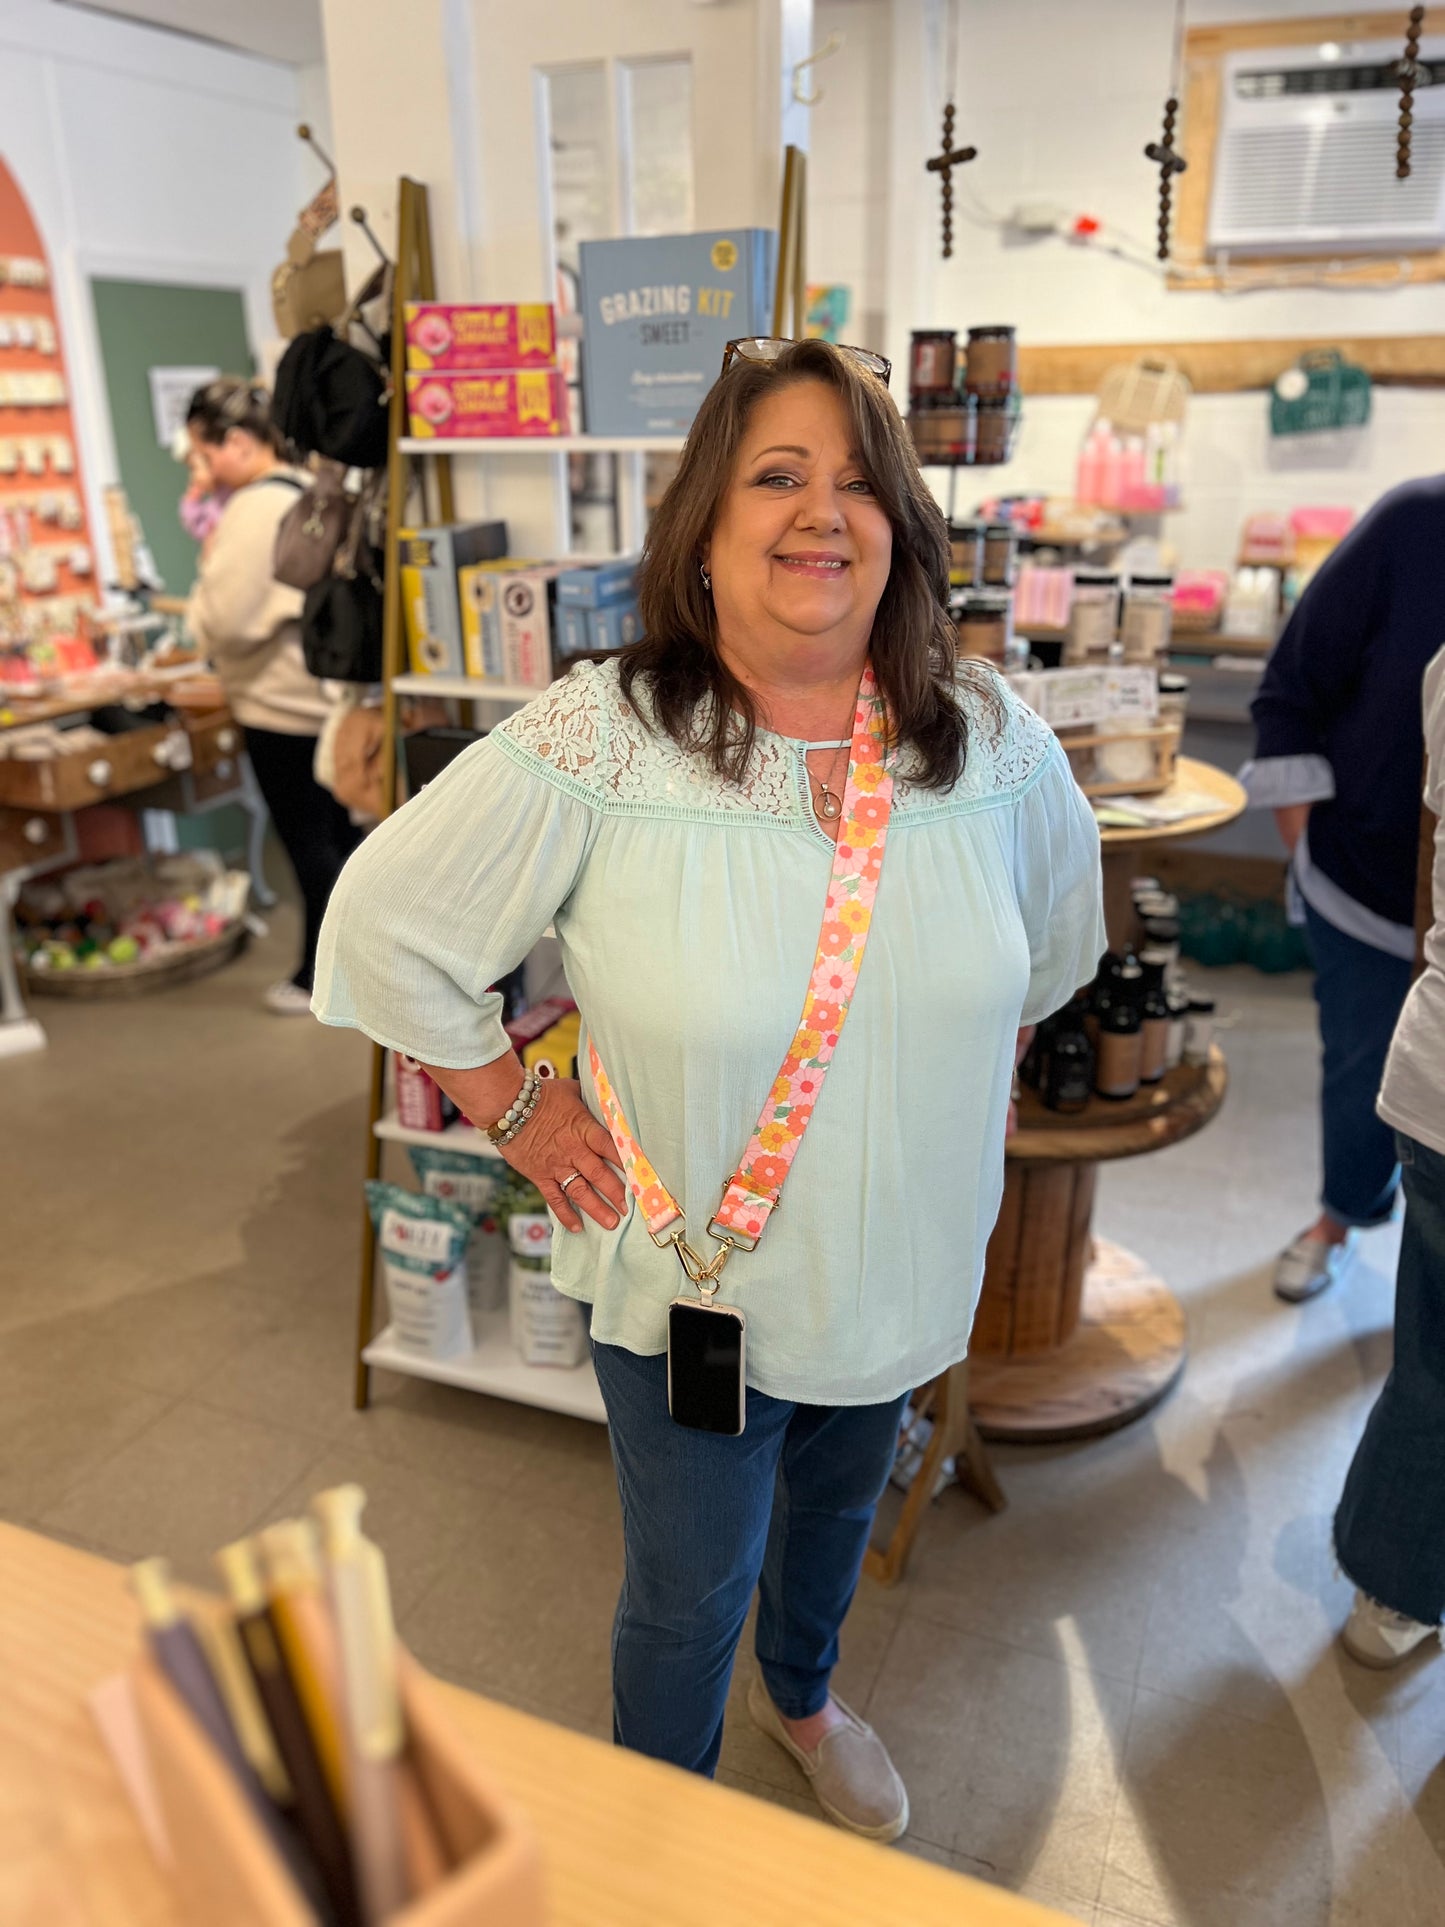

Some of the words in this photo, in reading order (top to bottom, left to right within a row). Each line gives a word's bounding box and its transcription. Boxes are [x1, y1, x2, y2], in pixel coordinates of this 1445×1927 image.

[600, 284, 691, 326] GRAZING
[696, 286, 735, 321] KIT
[640, 320, 691, 347] SWEET
